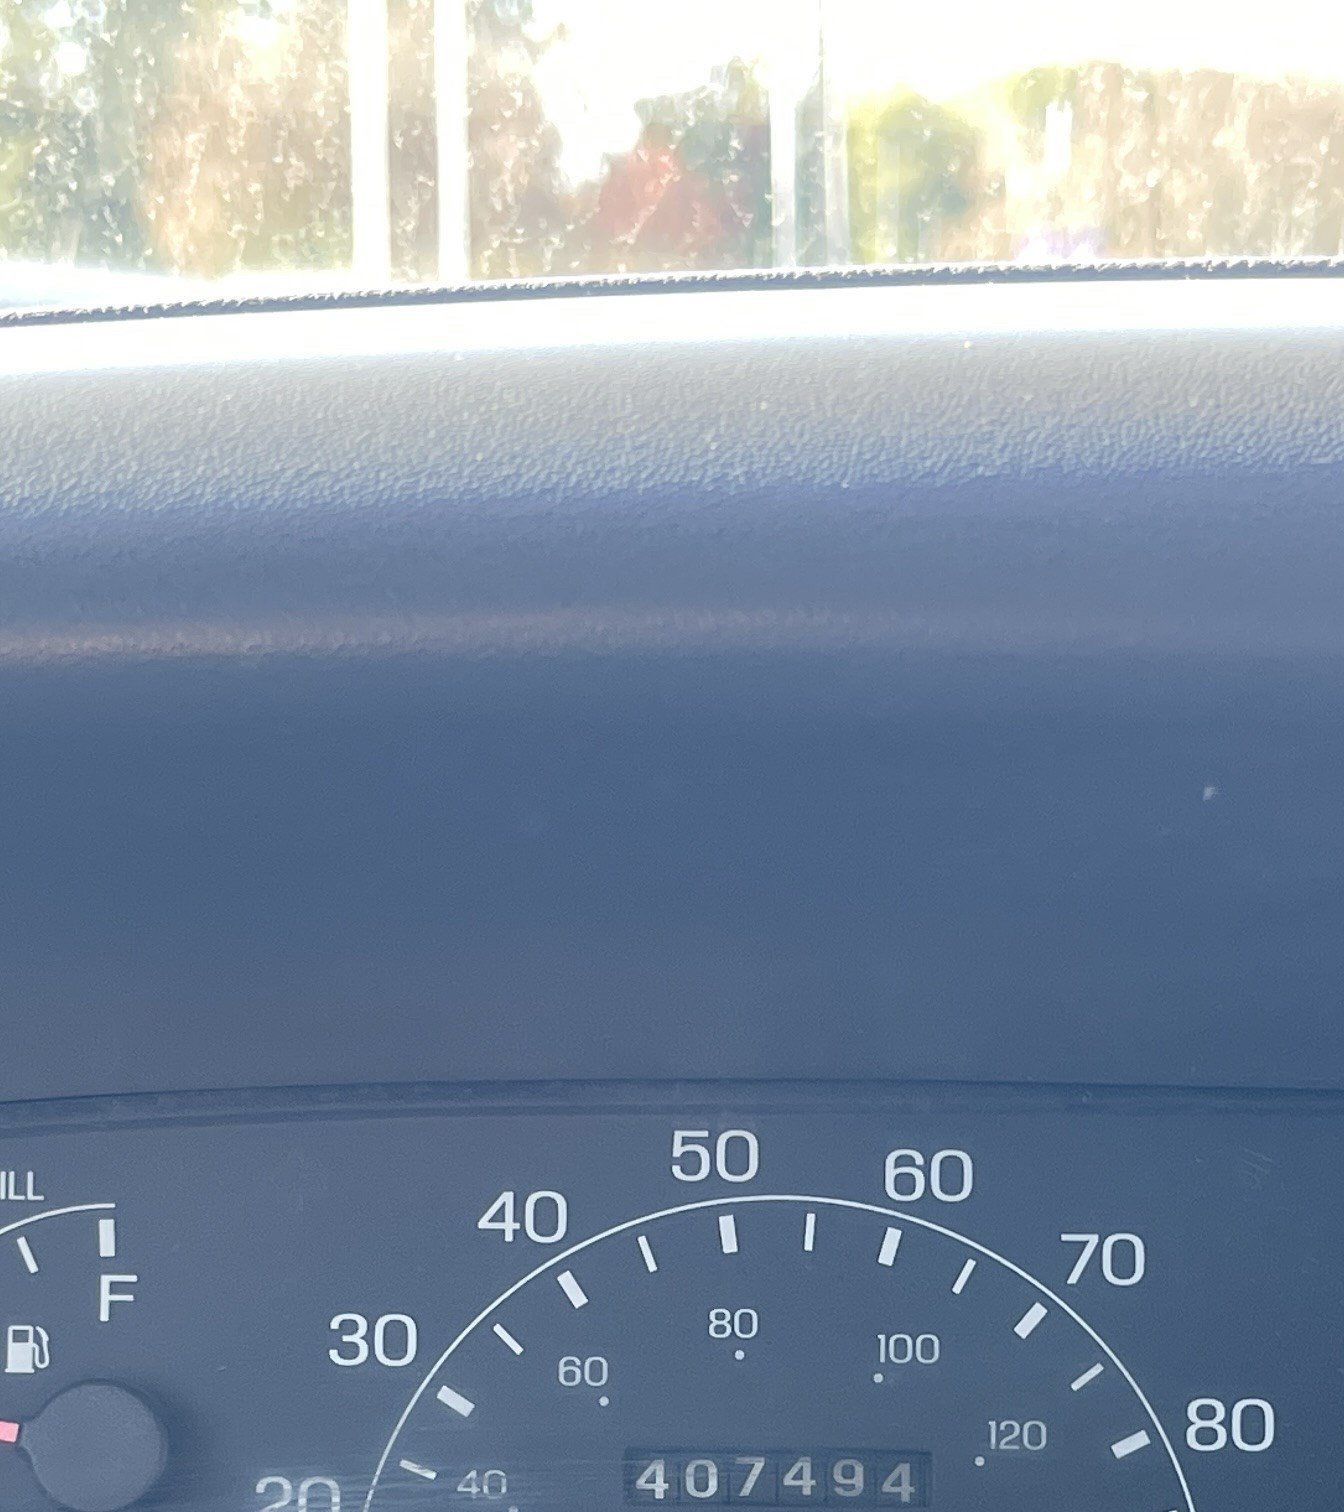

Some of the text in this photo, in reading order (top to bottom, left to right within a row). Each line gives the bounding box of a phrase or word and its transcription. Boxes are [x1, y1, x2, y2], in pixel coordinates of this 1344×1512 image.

[671, 1129, 759, 1183] 50
[885, 1149, 973, 1202] 60
[477, 1190, 567, 1244] 40
[1060, 1233, 1145, 1286] 70
[99, 1274, 138, 1322] F
[328, 1313, 417, 1367] 30
[708, 1308, 758, 1339] 80
[558, 1355, 608, 1387] 60
[877, 1333, 940, 1364] 100
[988, 1420, 1047, 1451] 120
[1186, 1398, 1275, 1452] 80
[456, 1468, 508, 1498] 40
[636, 1457, 914, 1501] 407494
